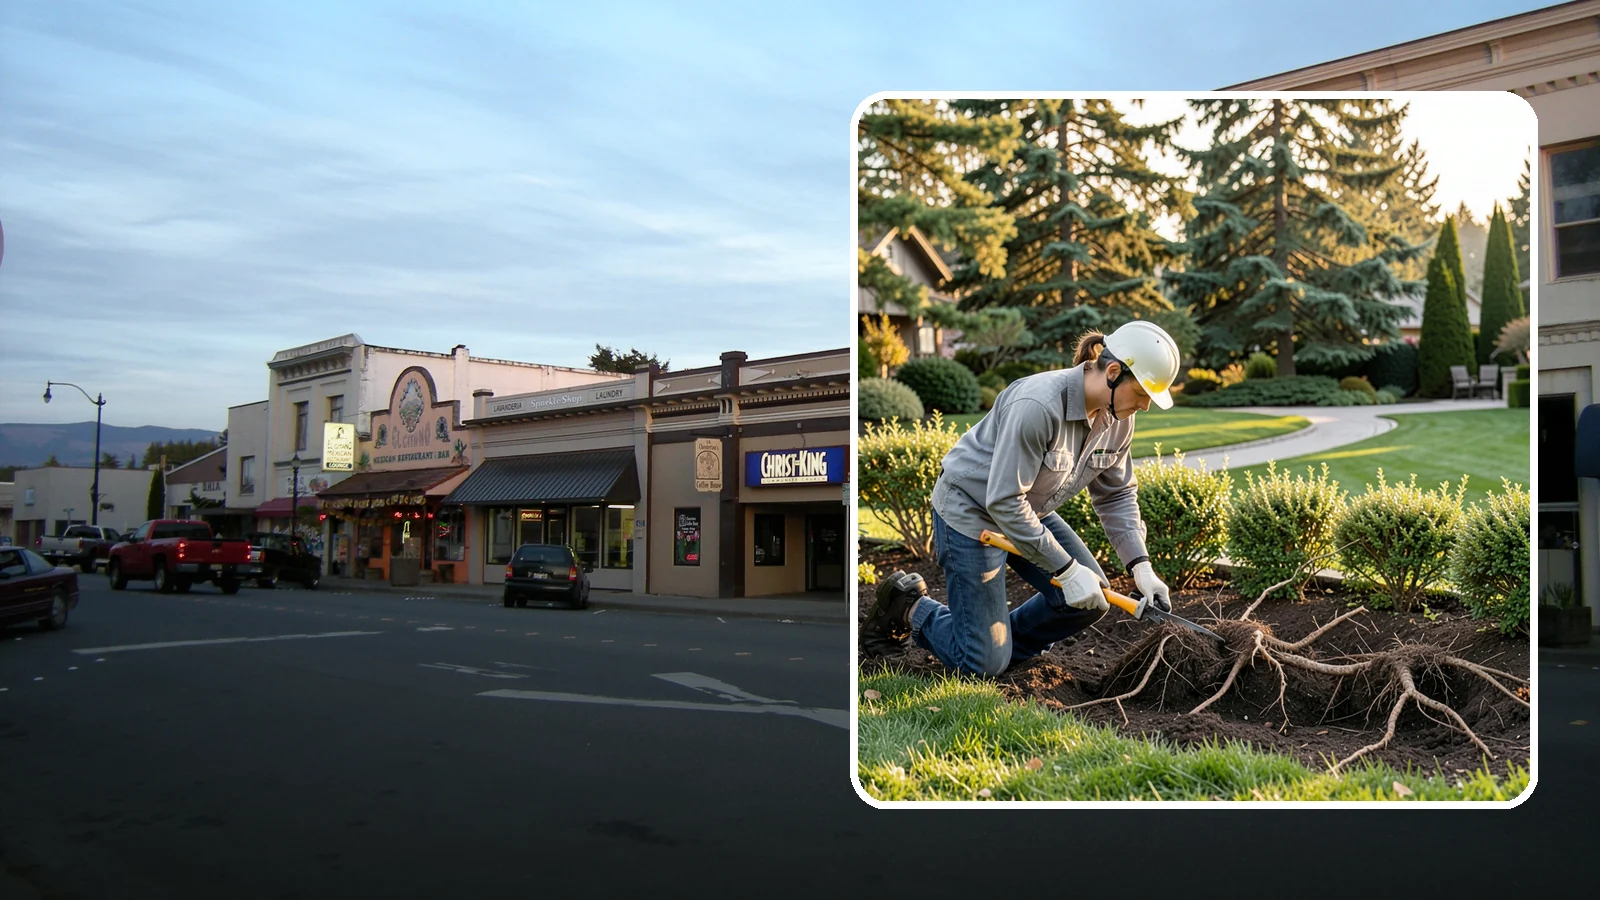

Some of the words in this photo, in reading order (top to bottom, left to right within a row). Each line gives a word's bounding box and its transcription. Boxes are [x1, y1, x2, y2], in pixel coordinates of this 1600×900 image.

[595, 389, 624, 400] LAUNDRY
[493, 402, 523, 413] LAVANDERIA
[530, 395, 561, 409] Sparkle
[562, 394, 583, 405] Shop
[373, 455, 396, 464] MEXICAN
[397, 452, 433, 462] RESTAURANT
[437, 450, 450, 459] BAR
[760, 452, 797, 478] CHRIST
[799, 450, 827, 476] KING
[696, 480, 709, 489] Coffee
